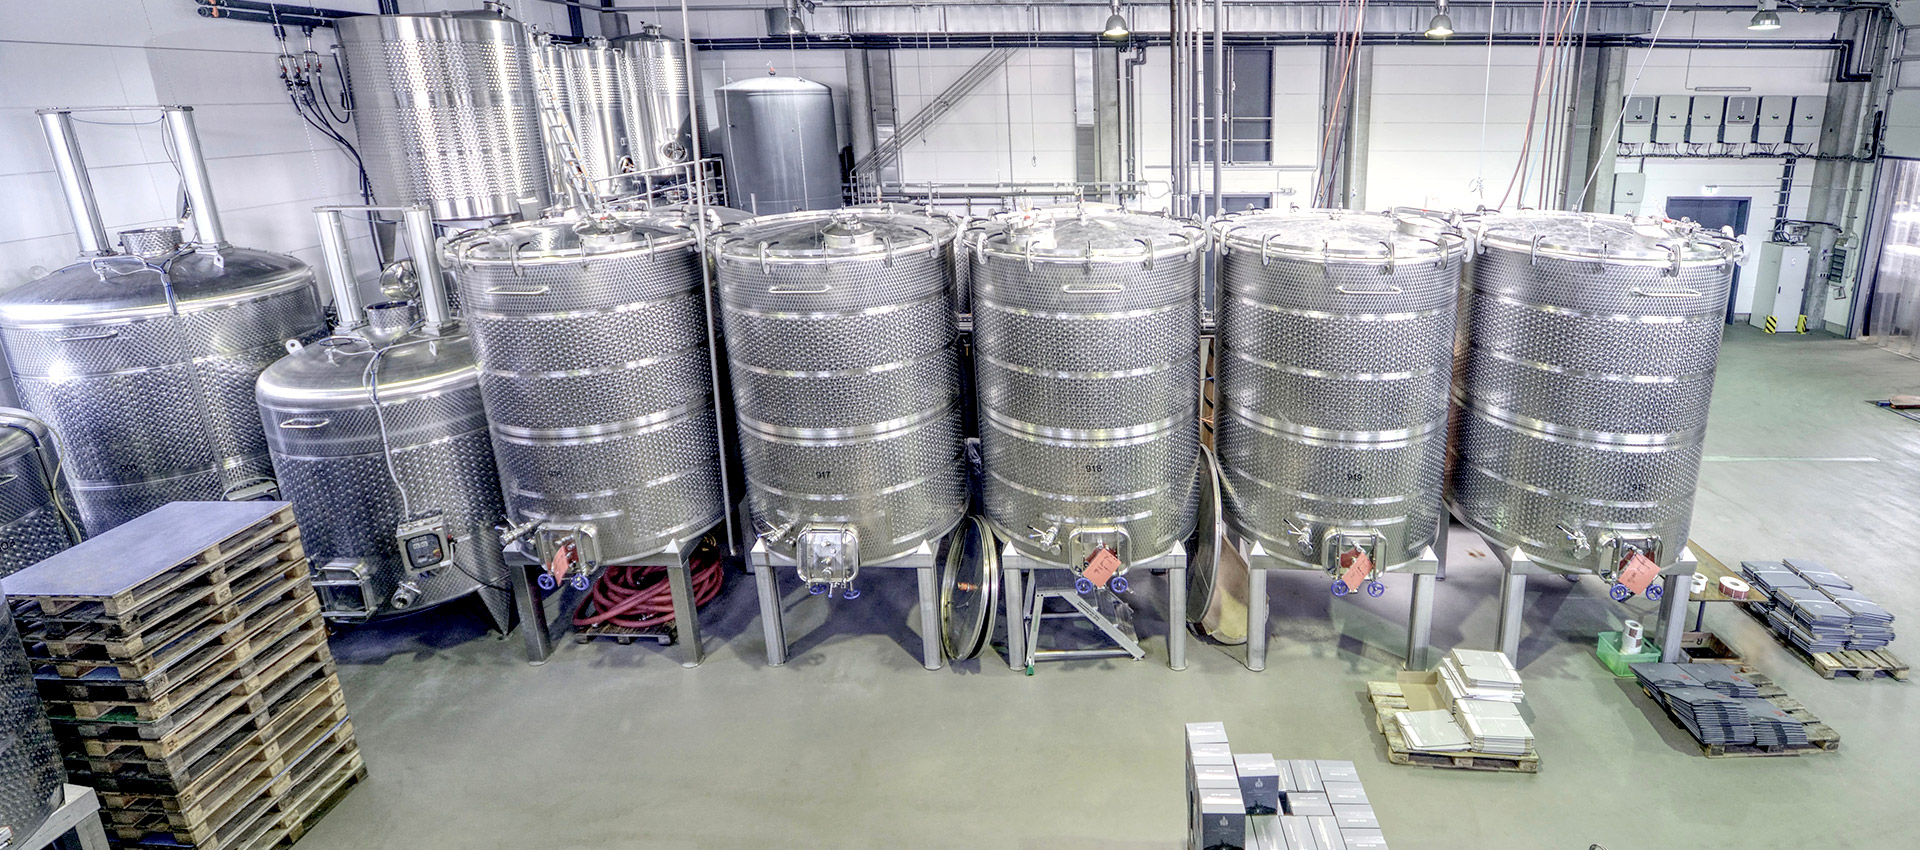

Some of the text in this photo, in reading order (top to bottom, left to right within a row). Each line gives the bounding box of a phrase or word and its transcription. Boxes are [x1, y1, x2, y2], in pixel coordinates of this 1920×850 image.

[1085, 465, 1103, 473] 918
[816, 471, 831, 479] 917
[1347, 473, 1363, 482] 919
